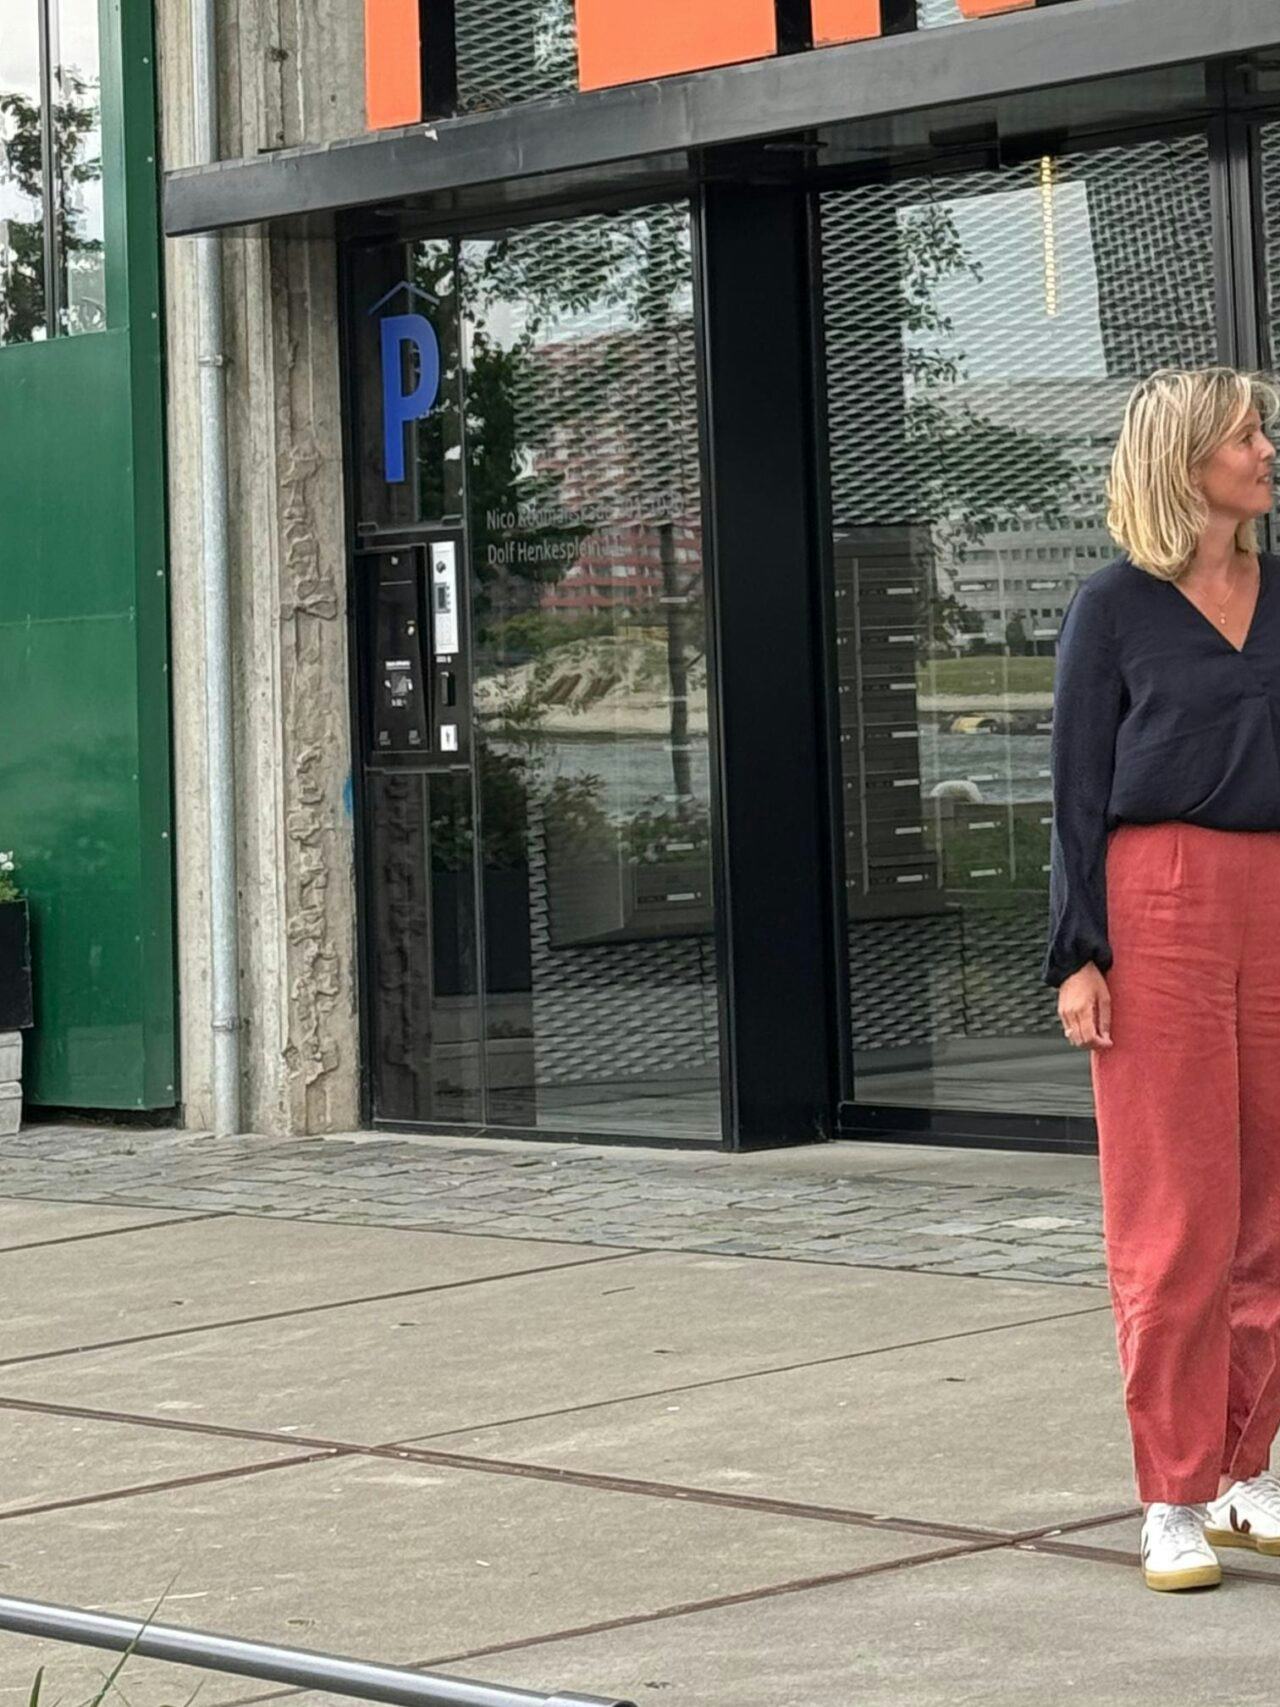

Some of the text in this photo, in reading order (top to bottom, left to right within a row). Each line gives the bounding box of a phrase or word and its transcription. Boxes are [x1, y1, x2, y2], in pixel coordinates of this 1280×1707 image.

[380, 314, 439, 483] P
[486, 507, 515, 530] Nico
[488, 541, 515, 564] Dolf
[518, 535, 600, 565] Henkesplein
